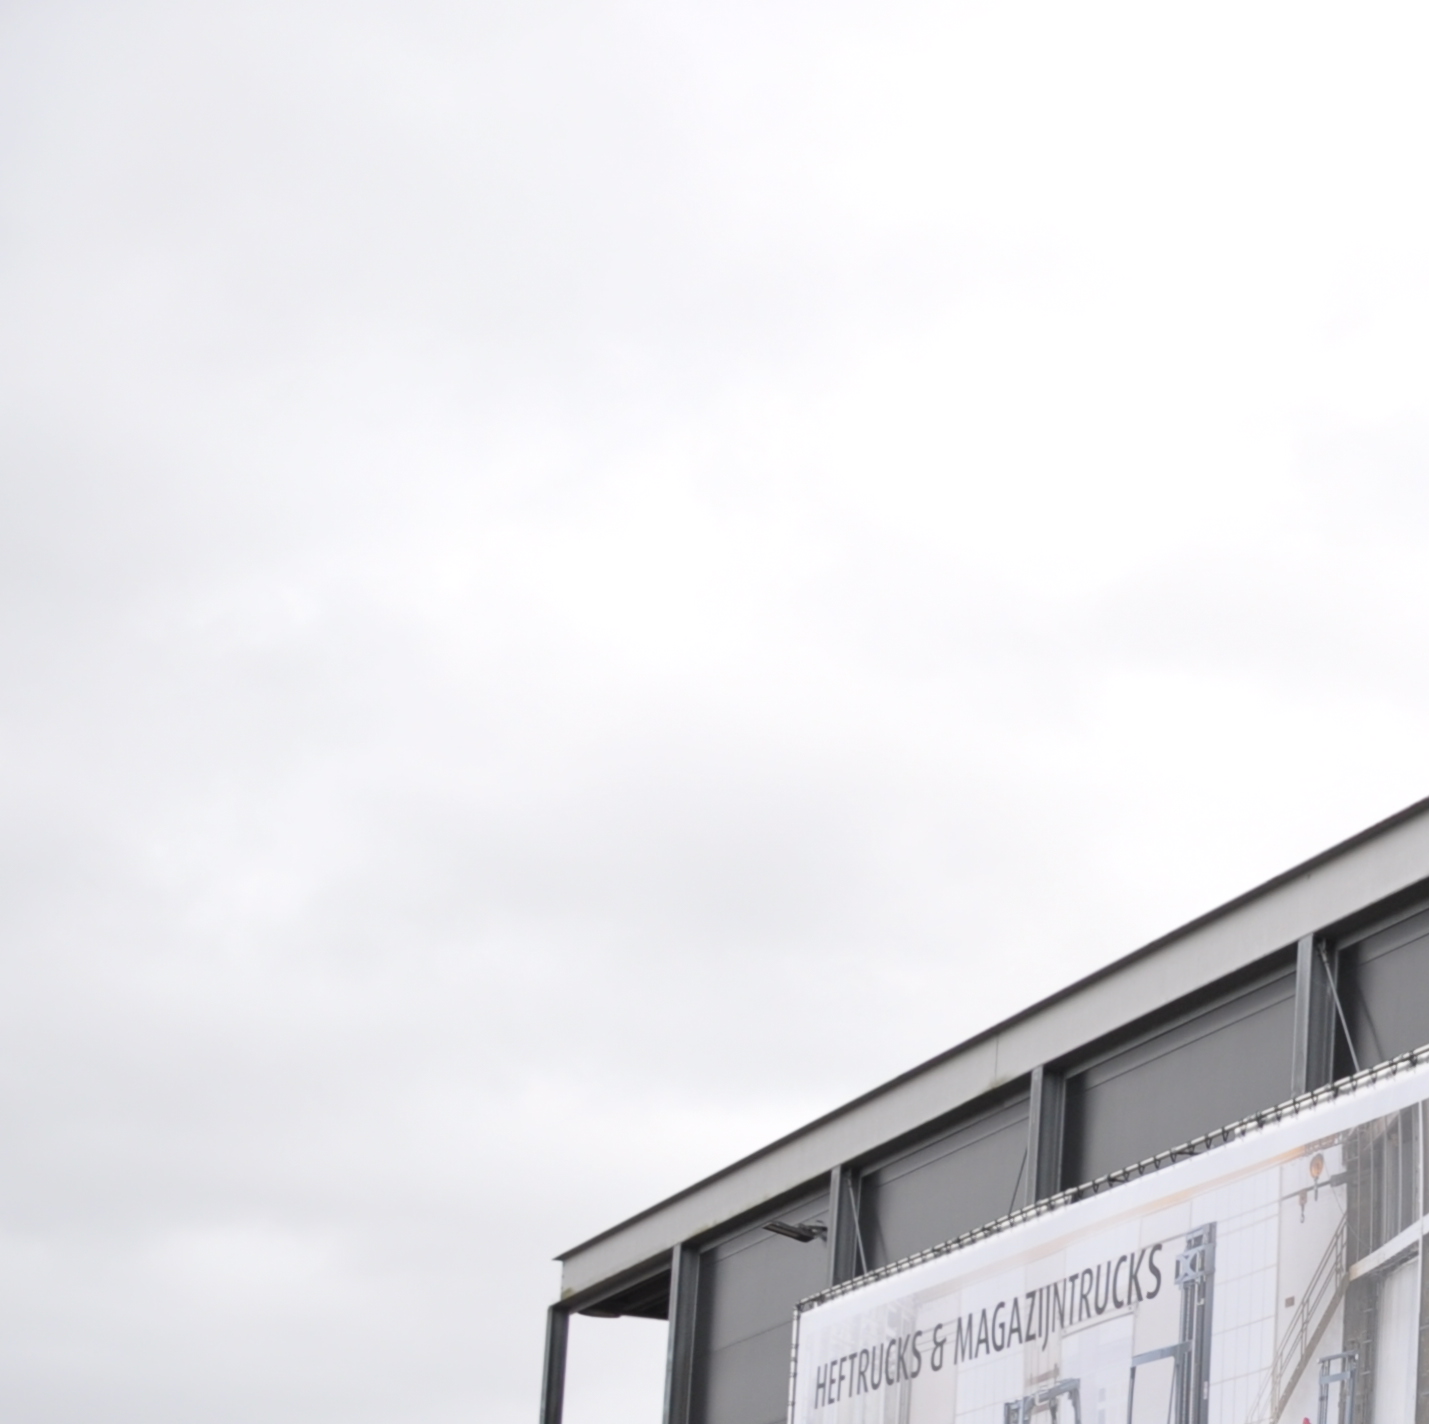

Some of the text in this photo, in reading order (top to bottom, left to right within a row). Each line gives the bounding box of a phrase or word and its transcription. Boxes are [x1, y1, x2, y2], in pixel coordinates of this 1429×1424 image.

[814, 1243, 1163, 1410] HEFTRUCKS & MAGAZIJNTRUCKS
